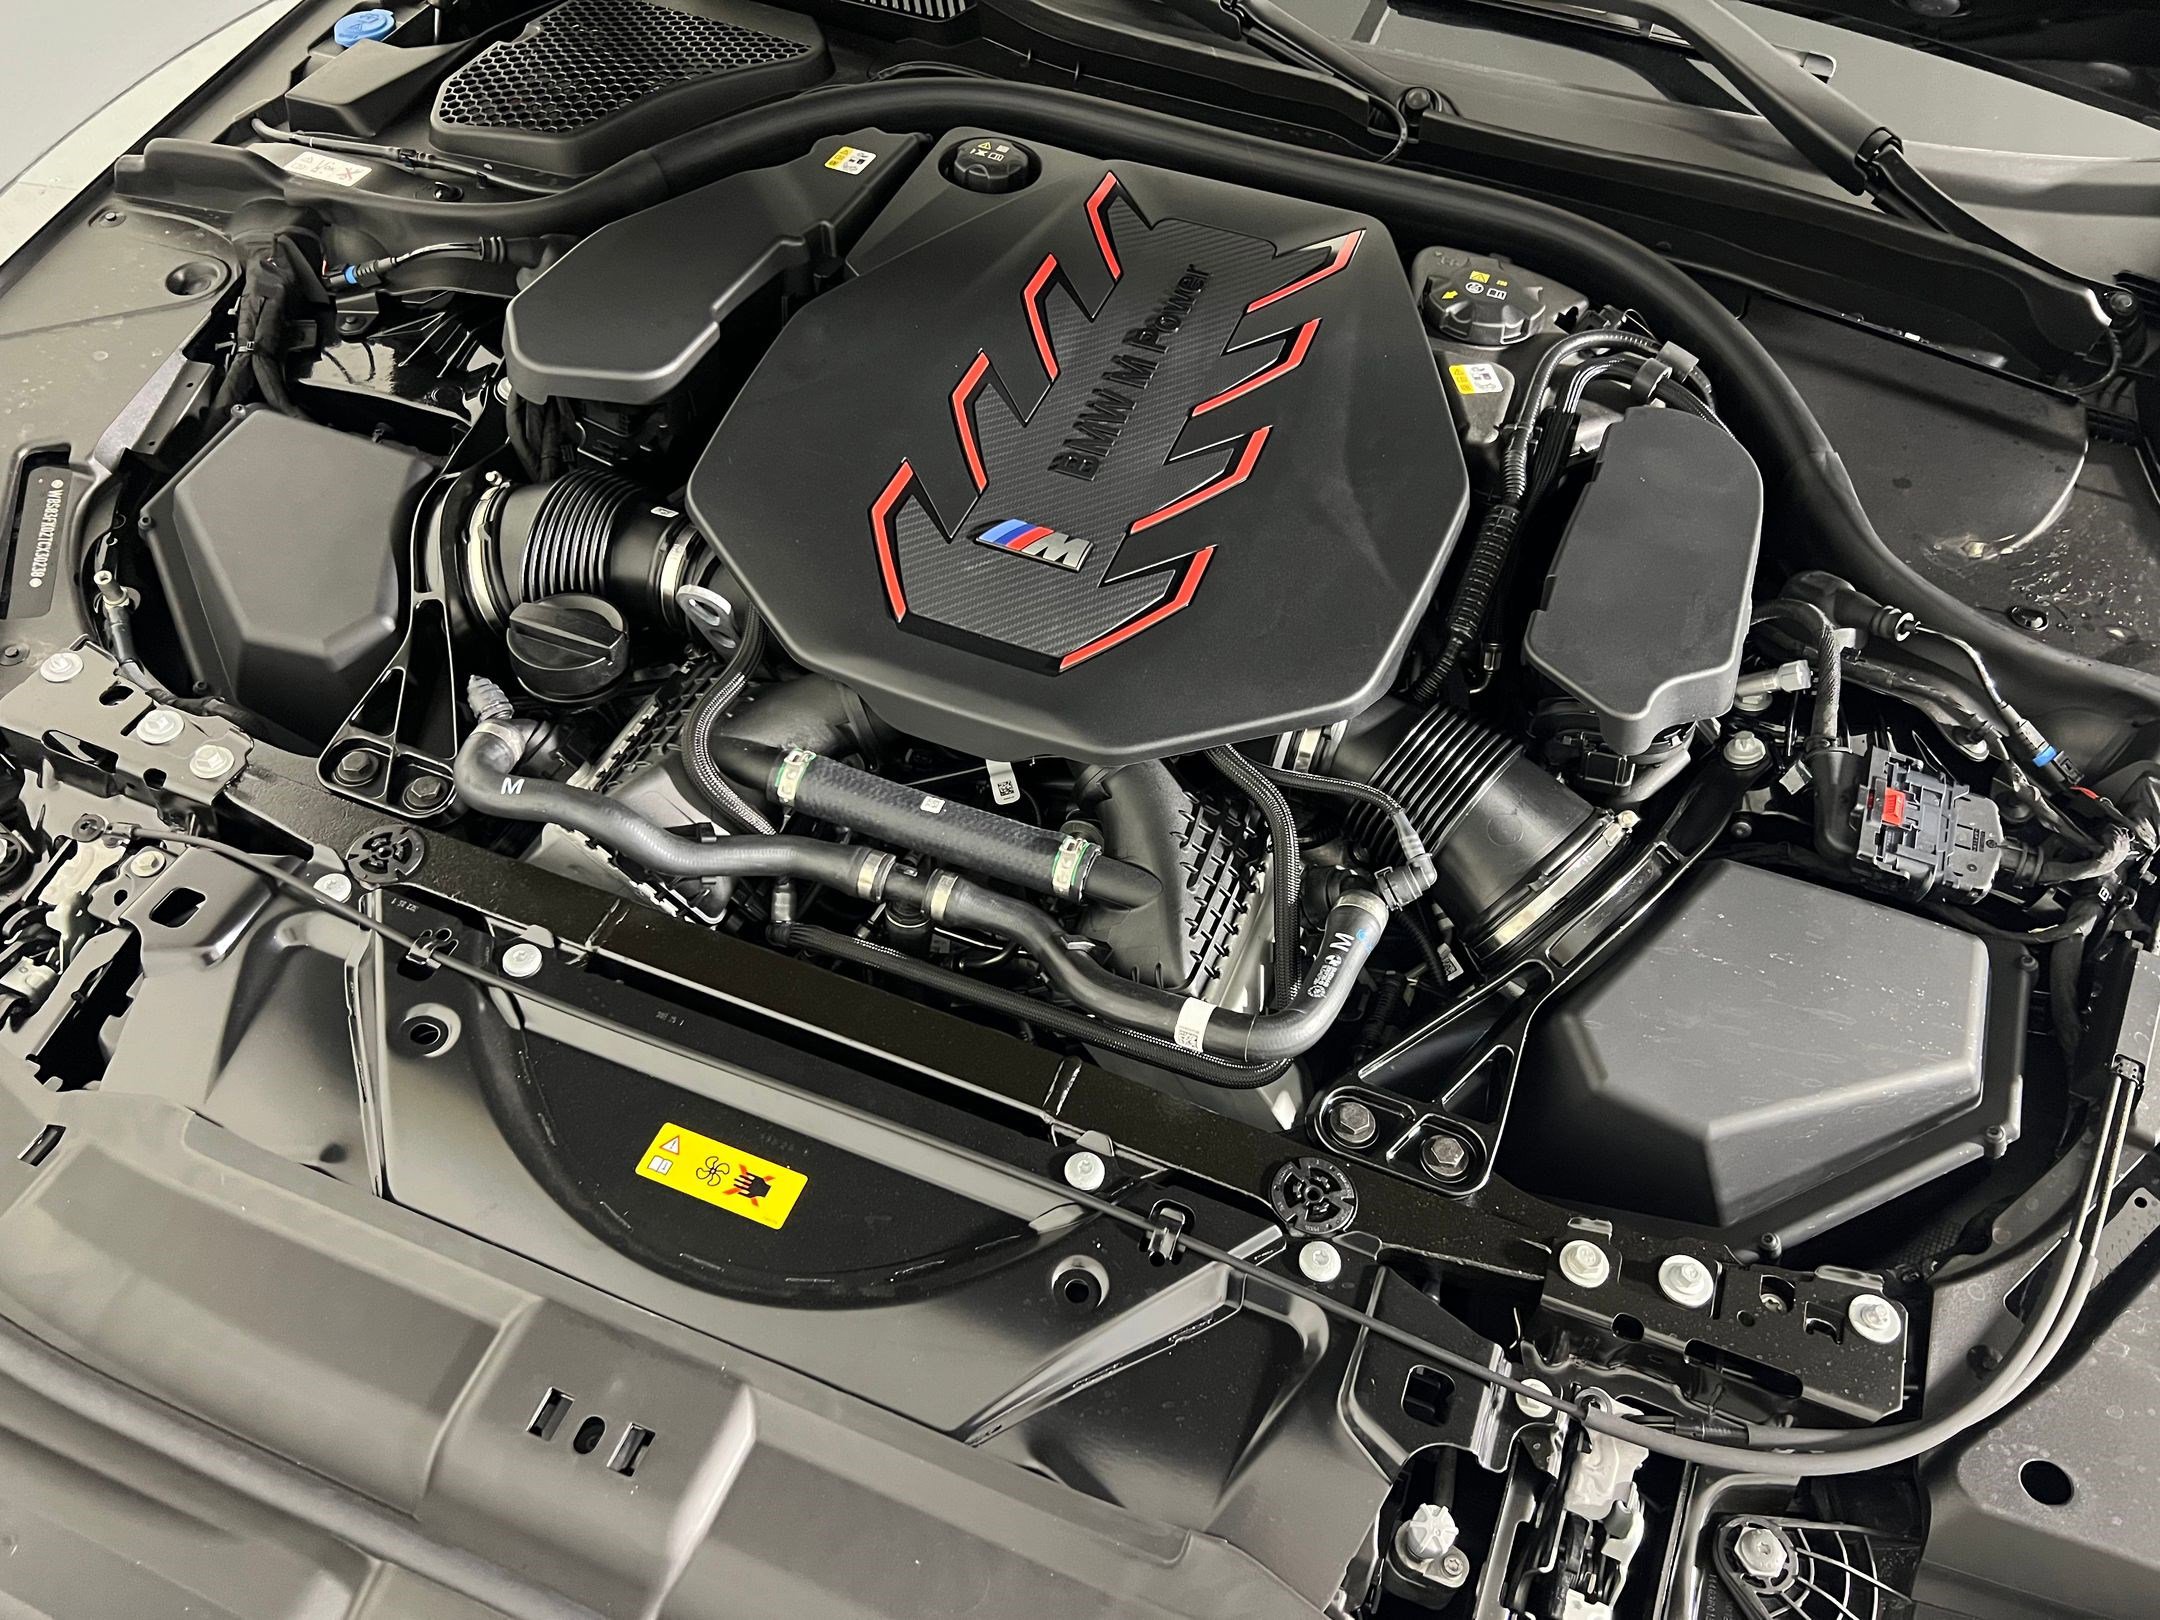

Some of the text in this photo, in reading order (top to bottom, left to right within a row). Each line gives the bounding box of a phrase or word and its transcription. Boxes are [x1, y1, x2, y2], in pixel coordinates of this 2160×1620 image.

[1048, 263, 1211, 482] BMW M Power
[500, 777, 526, 795] M
[1329, 932, 1355, 953] M
